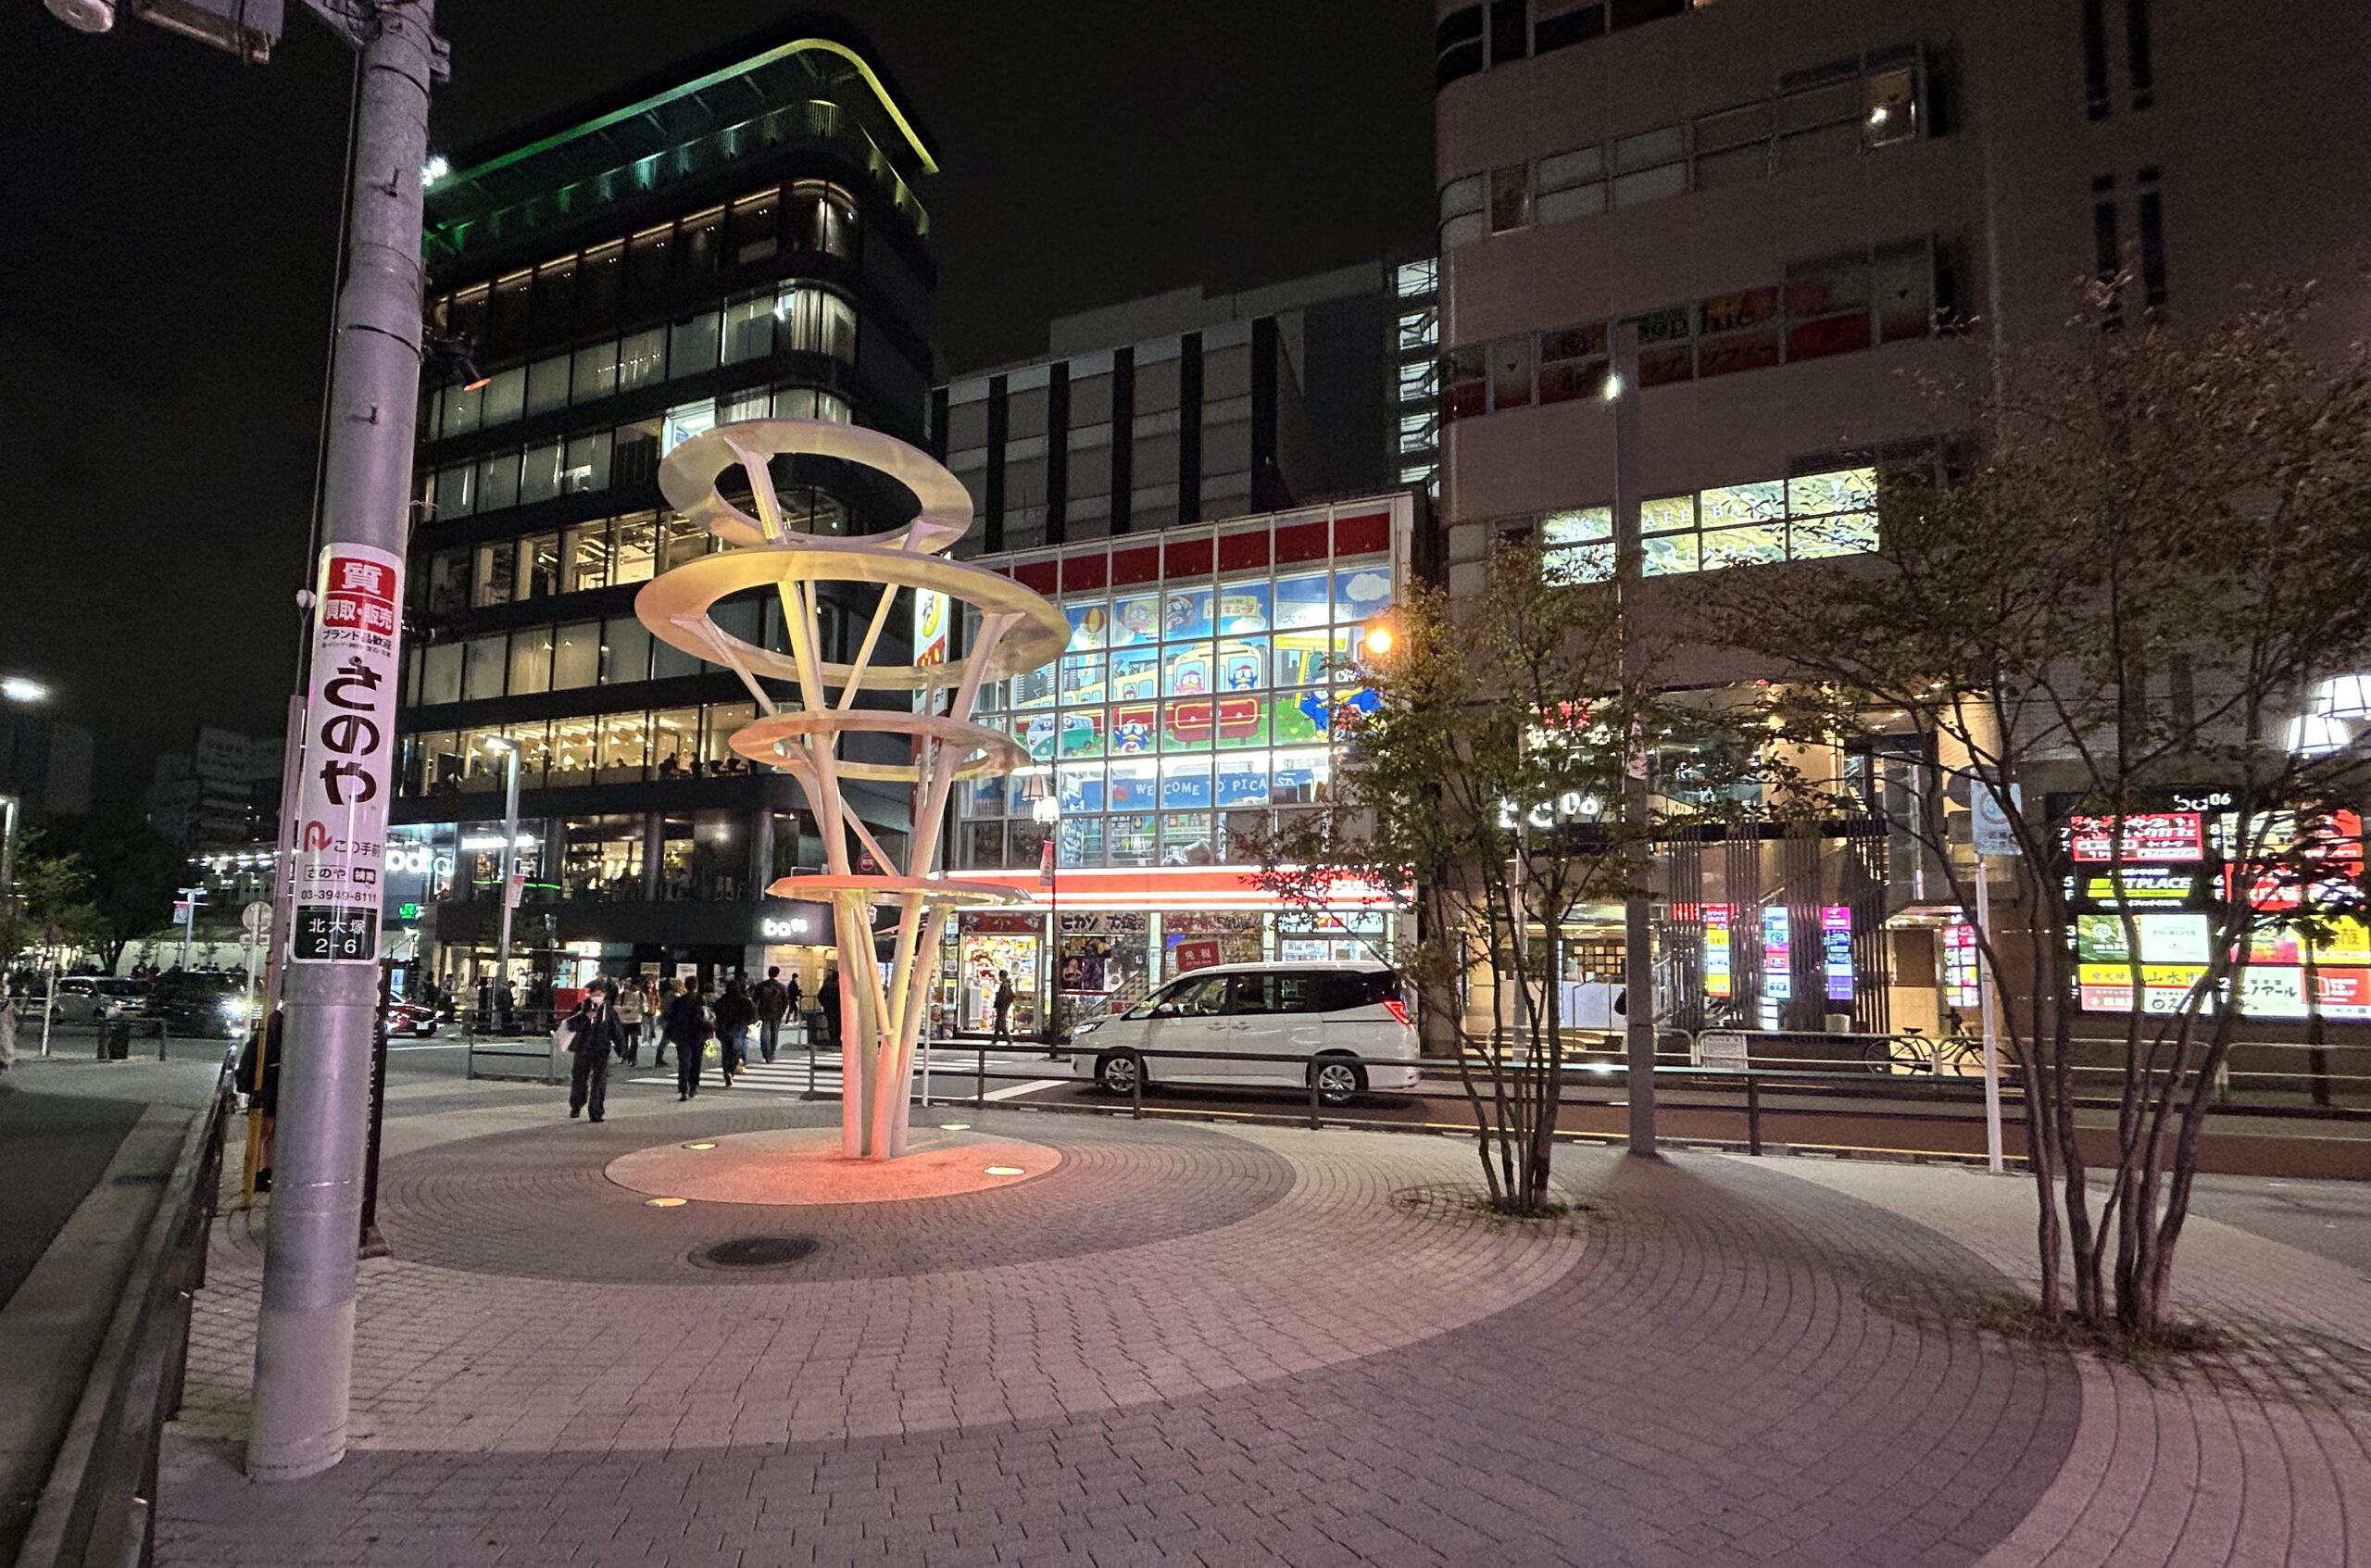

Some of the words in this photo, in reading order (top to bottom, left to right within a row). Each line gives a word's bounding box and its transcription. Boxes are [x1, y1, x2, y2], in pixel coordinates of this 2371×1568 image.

[343, 563, 382, 594] 質
[325, 600, 393, 630] 買取・販売
[320, 665, 383, 806] さのや
[334, 839, 381, 858] この手前
[308, 918, 366, 935] 北大塚
[315, 937, 357, 954] 2-6
